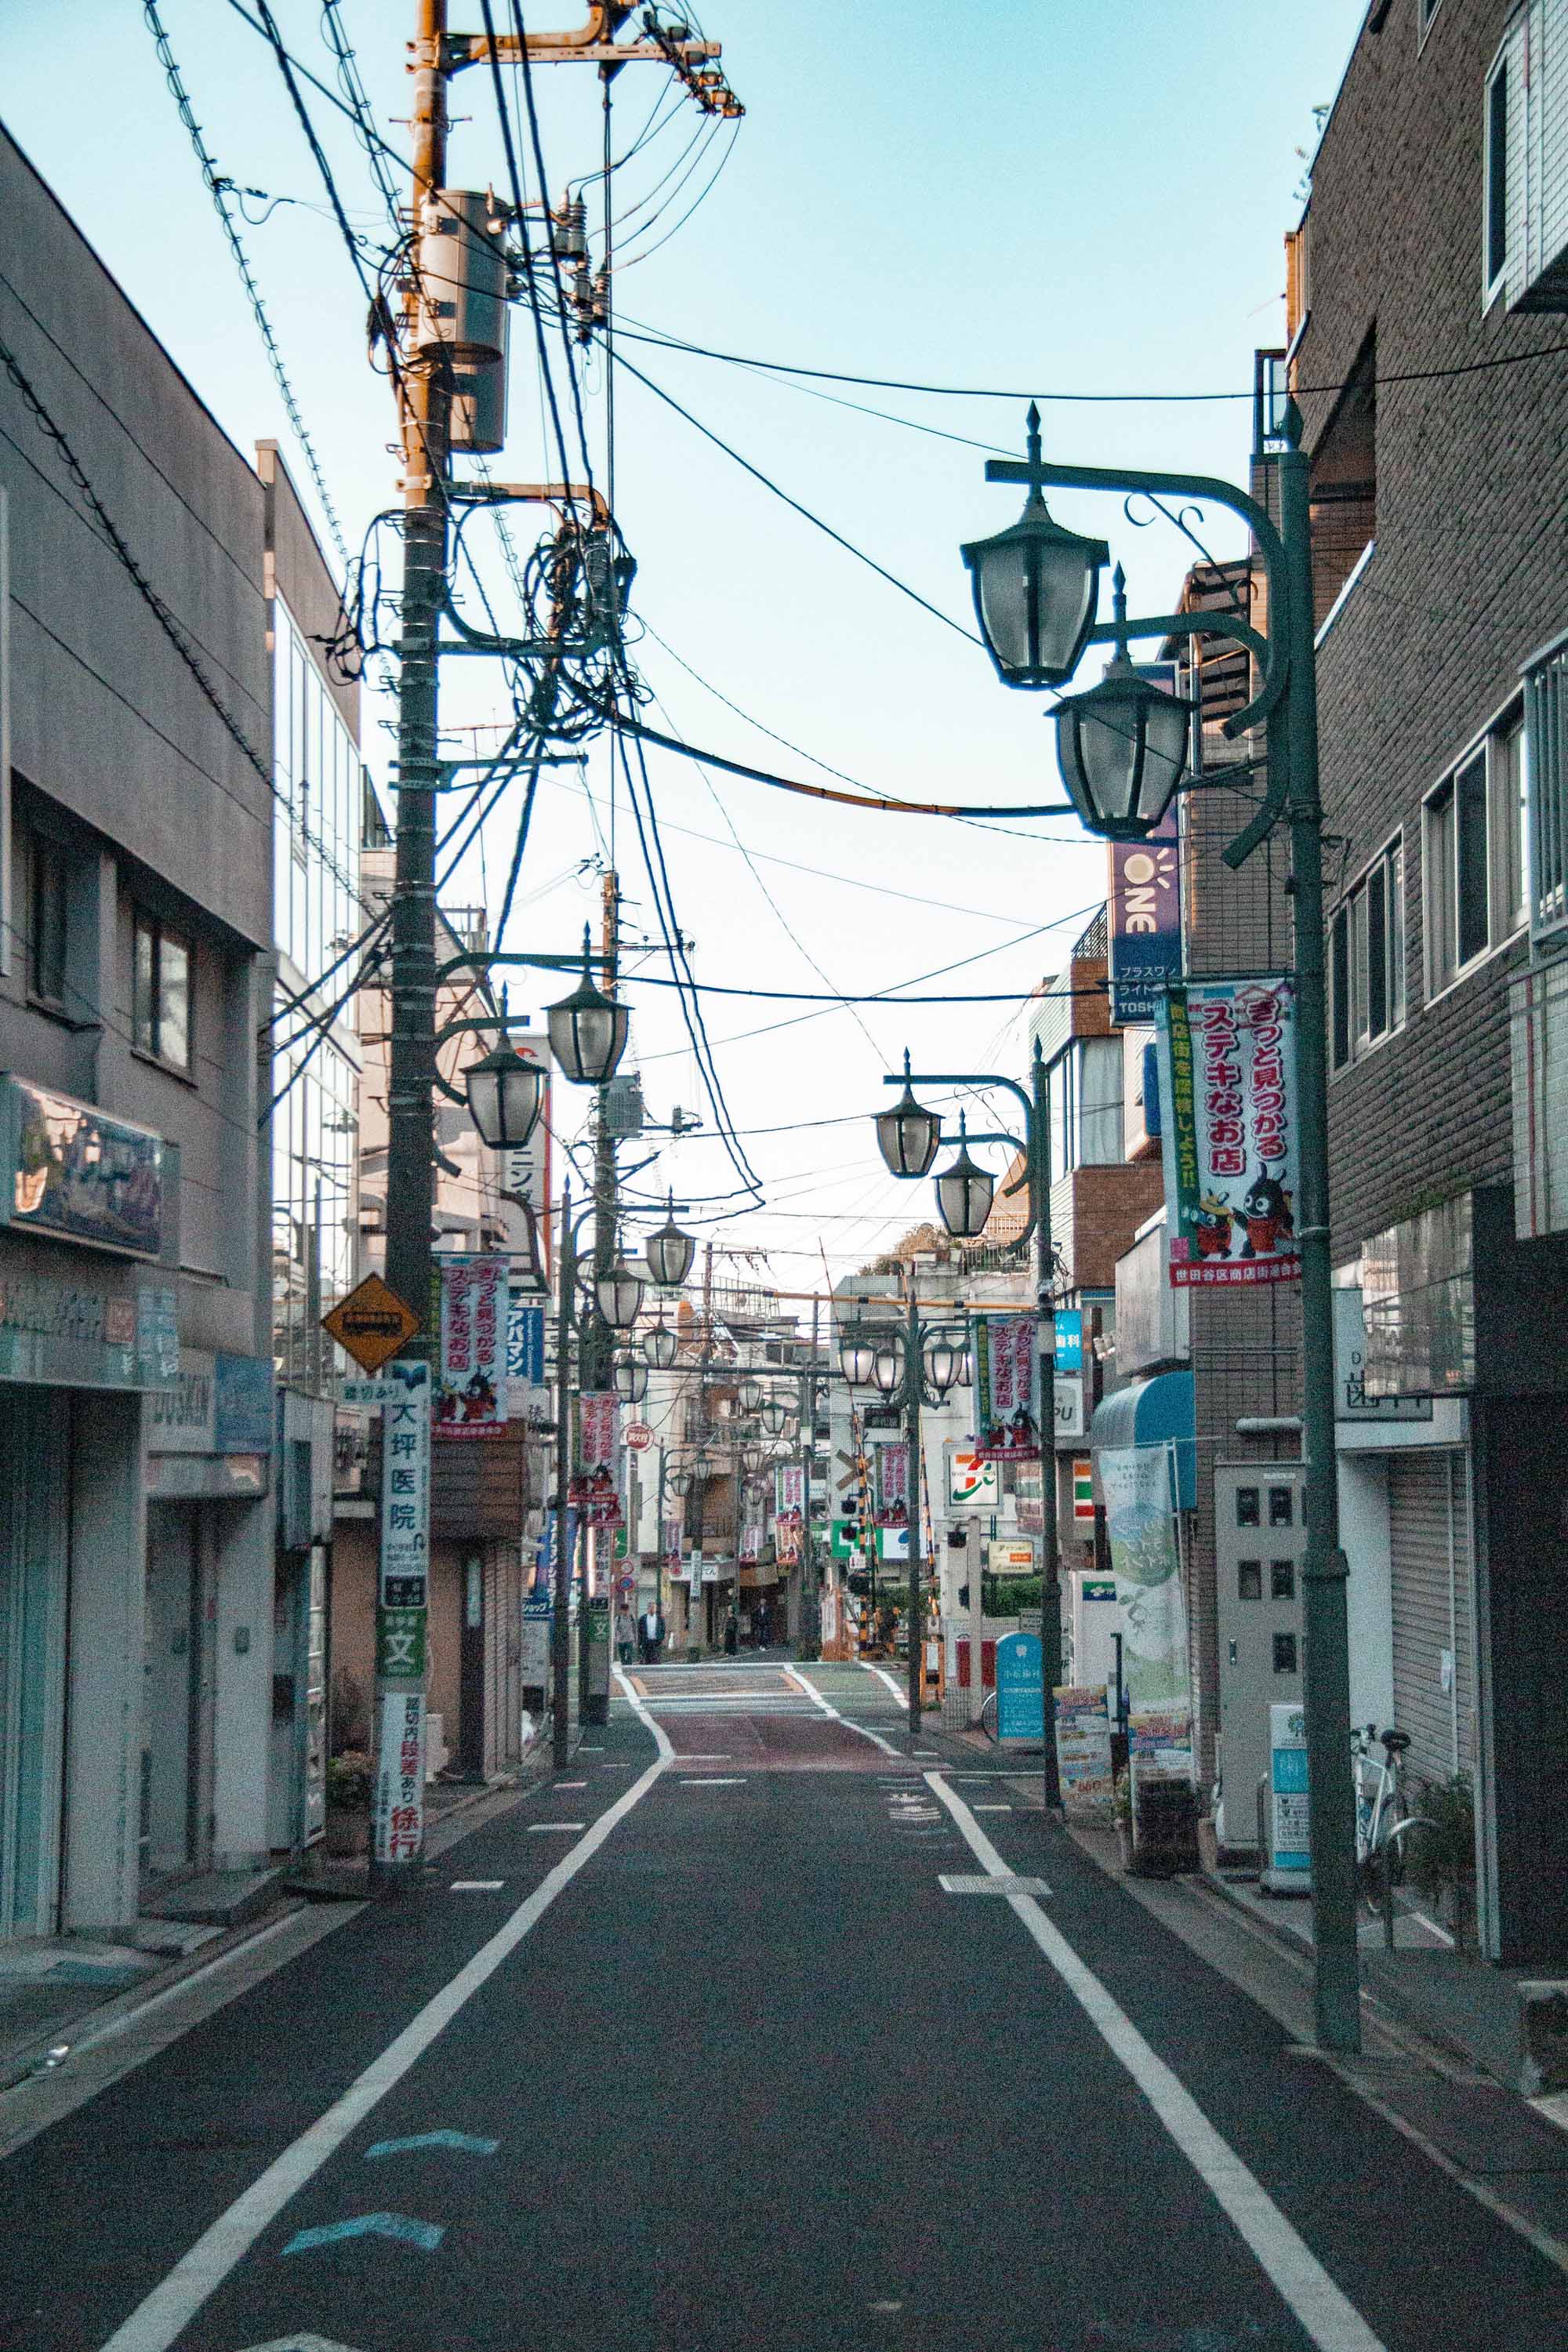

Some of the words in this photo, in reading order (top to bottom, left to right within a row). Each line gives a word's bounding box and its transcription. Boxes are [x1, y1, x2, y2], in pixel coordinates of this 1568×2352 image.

[1119, 1002, 1157, 1013] TOSH
[1200, 1004, 1247, 1178] ステキなお店
[1245, 997, 1287, 1162] きっと見つかる
[448, 1267, 470, 1371] ステキなお店
[477, 1266, 496, 1366] きっと見つかる
[506, 1310, 524, 1377] アパマン
[994, 1325, 1013, 1408] ステキなお店
[390, 1403, 417, 1530] 大坪医院
[384, 1629, 416, 1664] 文
[400, 1697, 420, 1803] 踏切内段差あり
[390, 1805, 420, 1859] 徐行
